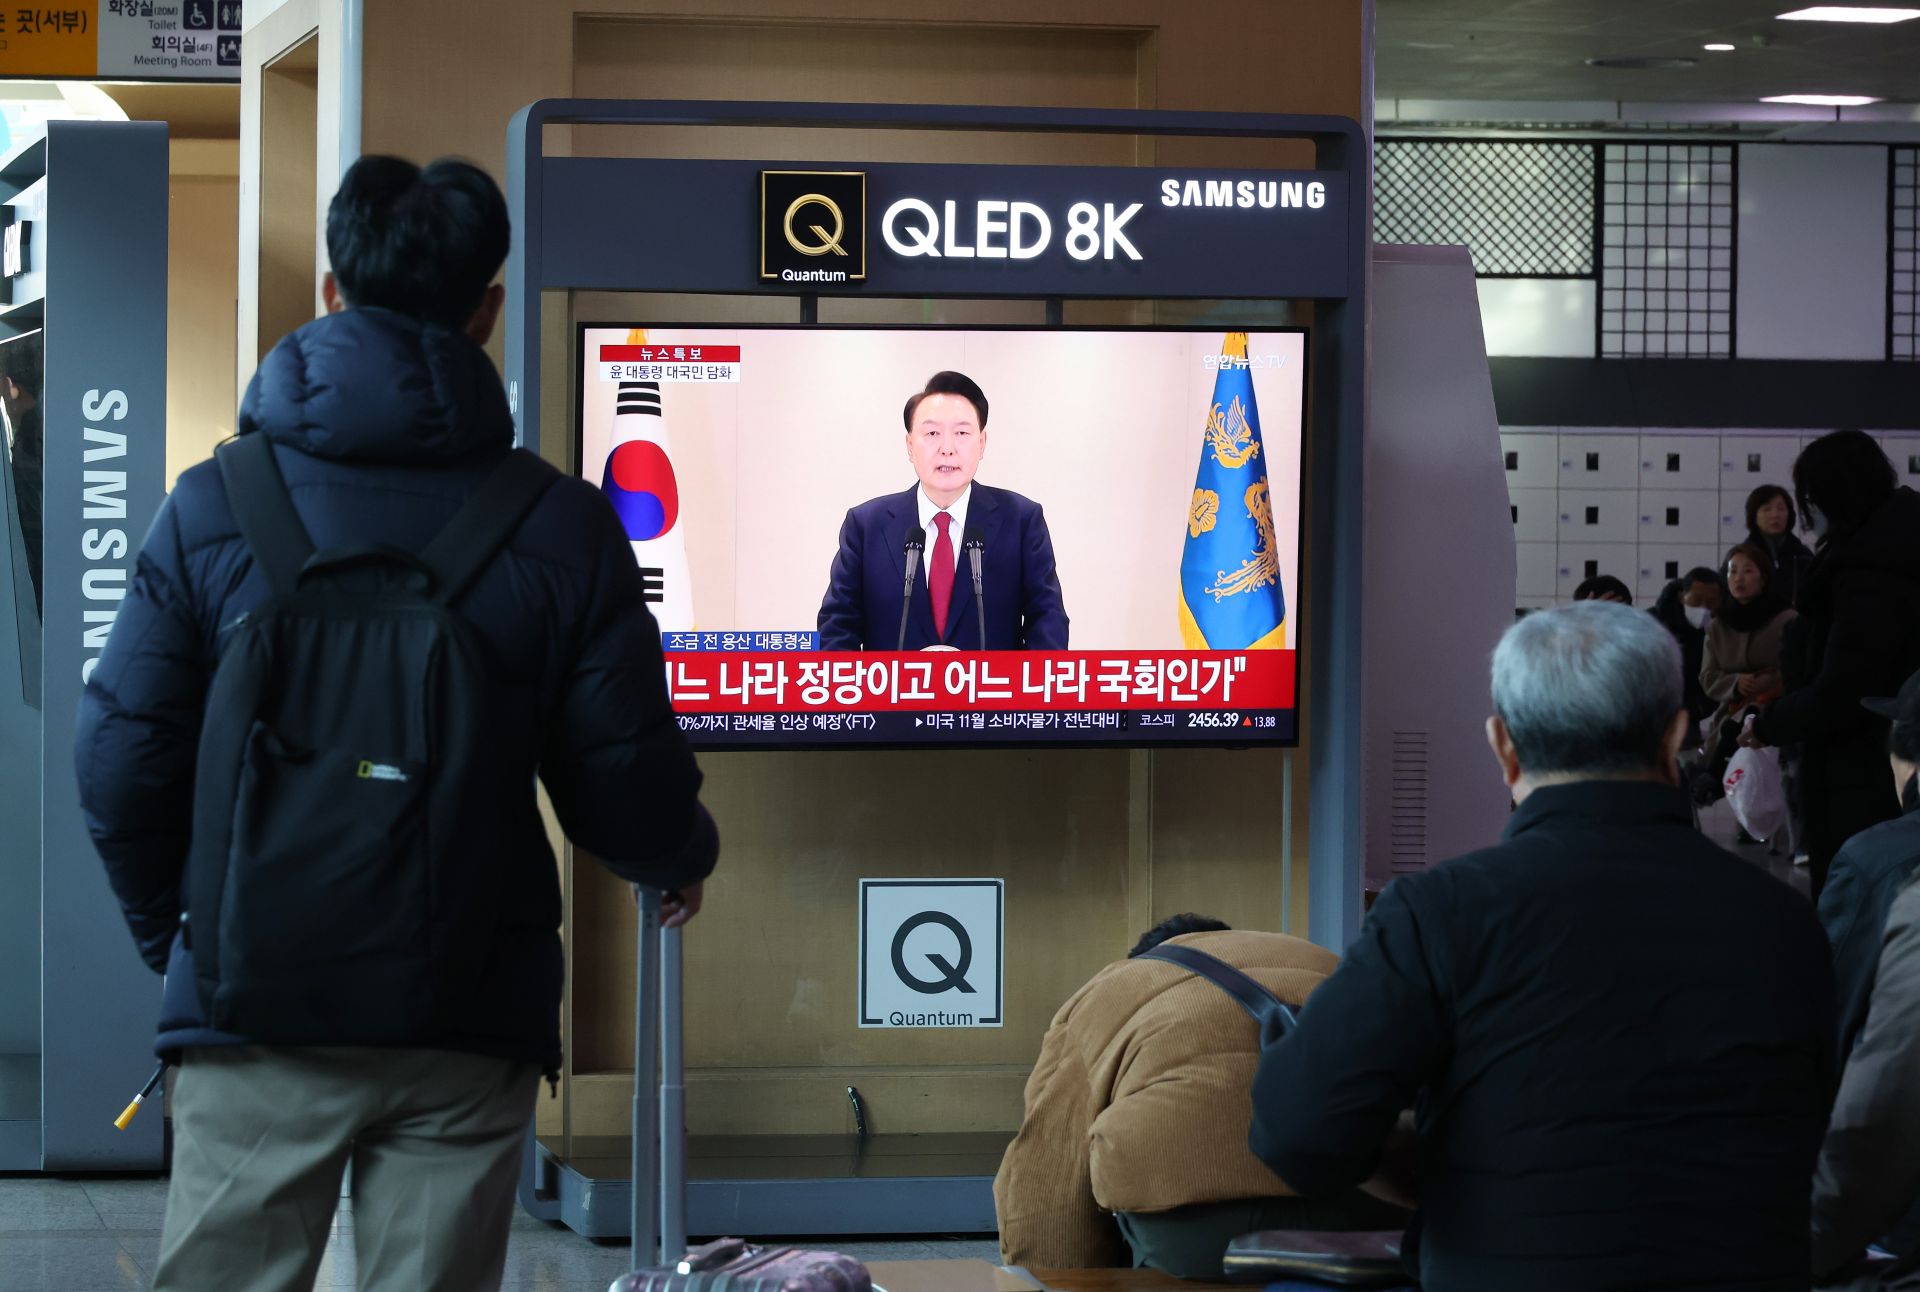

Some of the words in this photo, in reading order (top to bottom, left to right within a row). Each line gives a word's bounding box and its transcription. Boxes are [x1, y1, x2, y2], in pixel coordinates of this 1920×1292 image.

[16, 9, 87, 34] 곳(서부)
[149, 20, 176, 30] Toilet
[134, 55, 177, 68] Meeting
[181, 56, 212, 66] Room
[1161, 179, 1325, 209] SAMSUNG
[784, 193, 848, 257] Q
[882, 198, 1052, 260] QLED
[1065, 203, 1144, 262] 8K
[781, 269, 846, 283] Quantum
[610, 364, 623, 380] 윤
[626, 364, 663, 380] 대통령
[666, 364, 703, 380] 대국민
[707, 364, 732, 380] 담화
[82, 389, 128, 686] SAMSUN
[669, 634, 699, 650] 조금
[703, 633, 718, 650] 전
[721, 633, 751, 650] 용산
[755, 633, 812, 650] 대통령실
[719, 660, 788, 704] 나라
[796, 660, 935, 705] 정당이고
[944, 659, 1013, 703] 어느
[1022, 659, 1090, 703] 나라
[1097, 656, 1246, 703] 국회인가"
[733, 714, 776, 731] 관세율
[780, 714, 809, 731] 인상
[926, 713, 954, 729] 미국
[958, 713, 985, 729] 11월
[988, 712, 1060, 729] 소비자물가
[1063, 712, 1119, 729] 전년대비
[1139, 713, 1175, 727] 코스피
[1188, 712, 1239, 728] 2456.39
[890, 911, 978, 994] Q
[890, 1010, 973, 1026] Quantum
